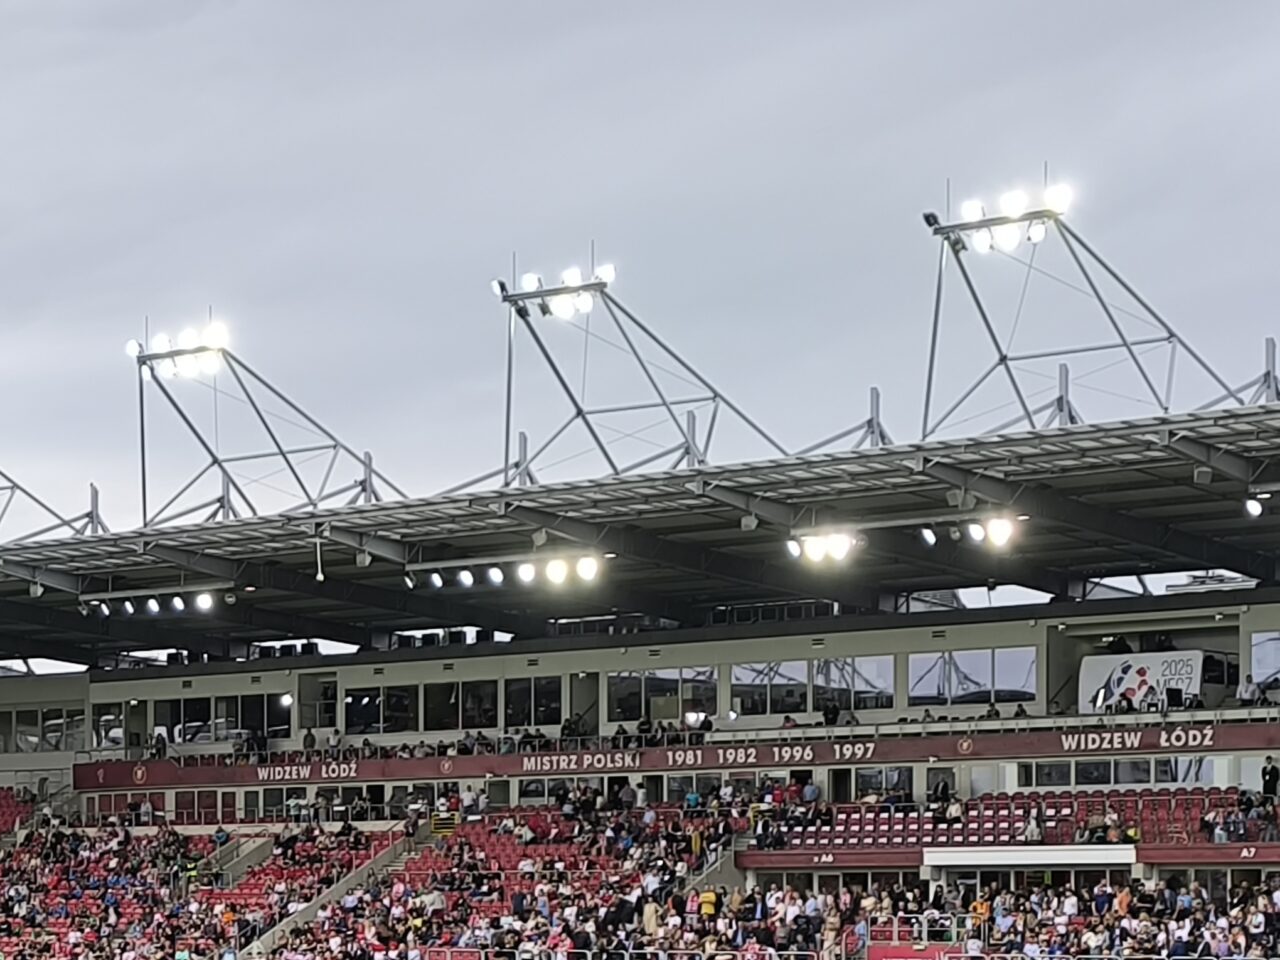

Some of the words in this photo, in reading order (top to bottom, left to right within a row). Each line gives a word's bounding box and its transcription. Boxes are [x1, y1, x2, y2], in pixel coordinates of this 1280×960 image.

[1161, 658, 1193, 677] 2025
[1061, 731, 1142, 750] WIDZEW
[1160, 725, 1214, 747] ŁÓDŹ
[522, 754, 578, 772] MISTRZ
[583, 750, 640, 769] POLSKI
[666, 749, 703, 766] 1981
[717, 747, 757, 764] 1982
[772, 745, 813, 762] 1996
[833, 743, 875, 760] 1997
[257, 765, 312, 780] WIDZEW
[321, 759, 357, 778] ŁÓDŹ
[1240, 847, 1256, 858] A7
